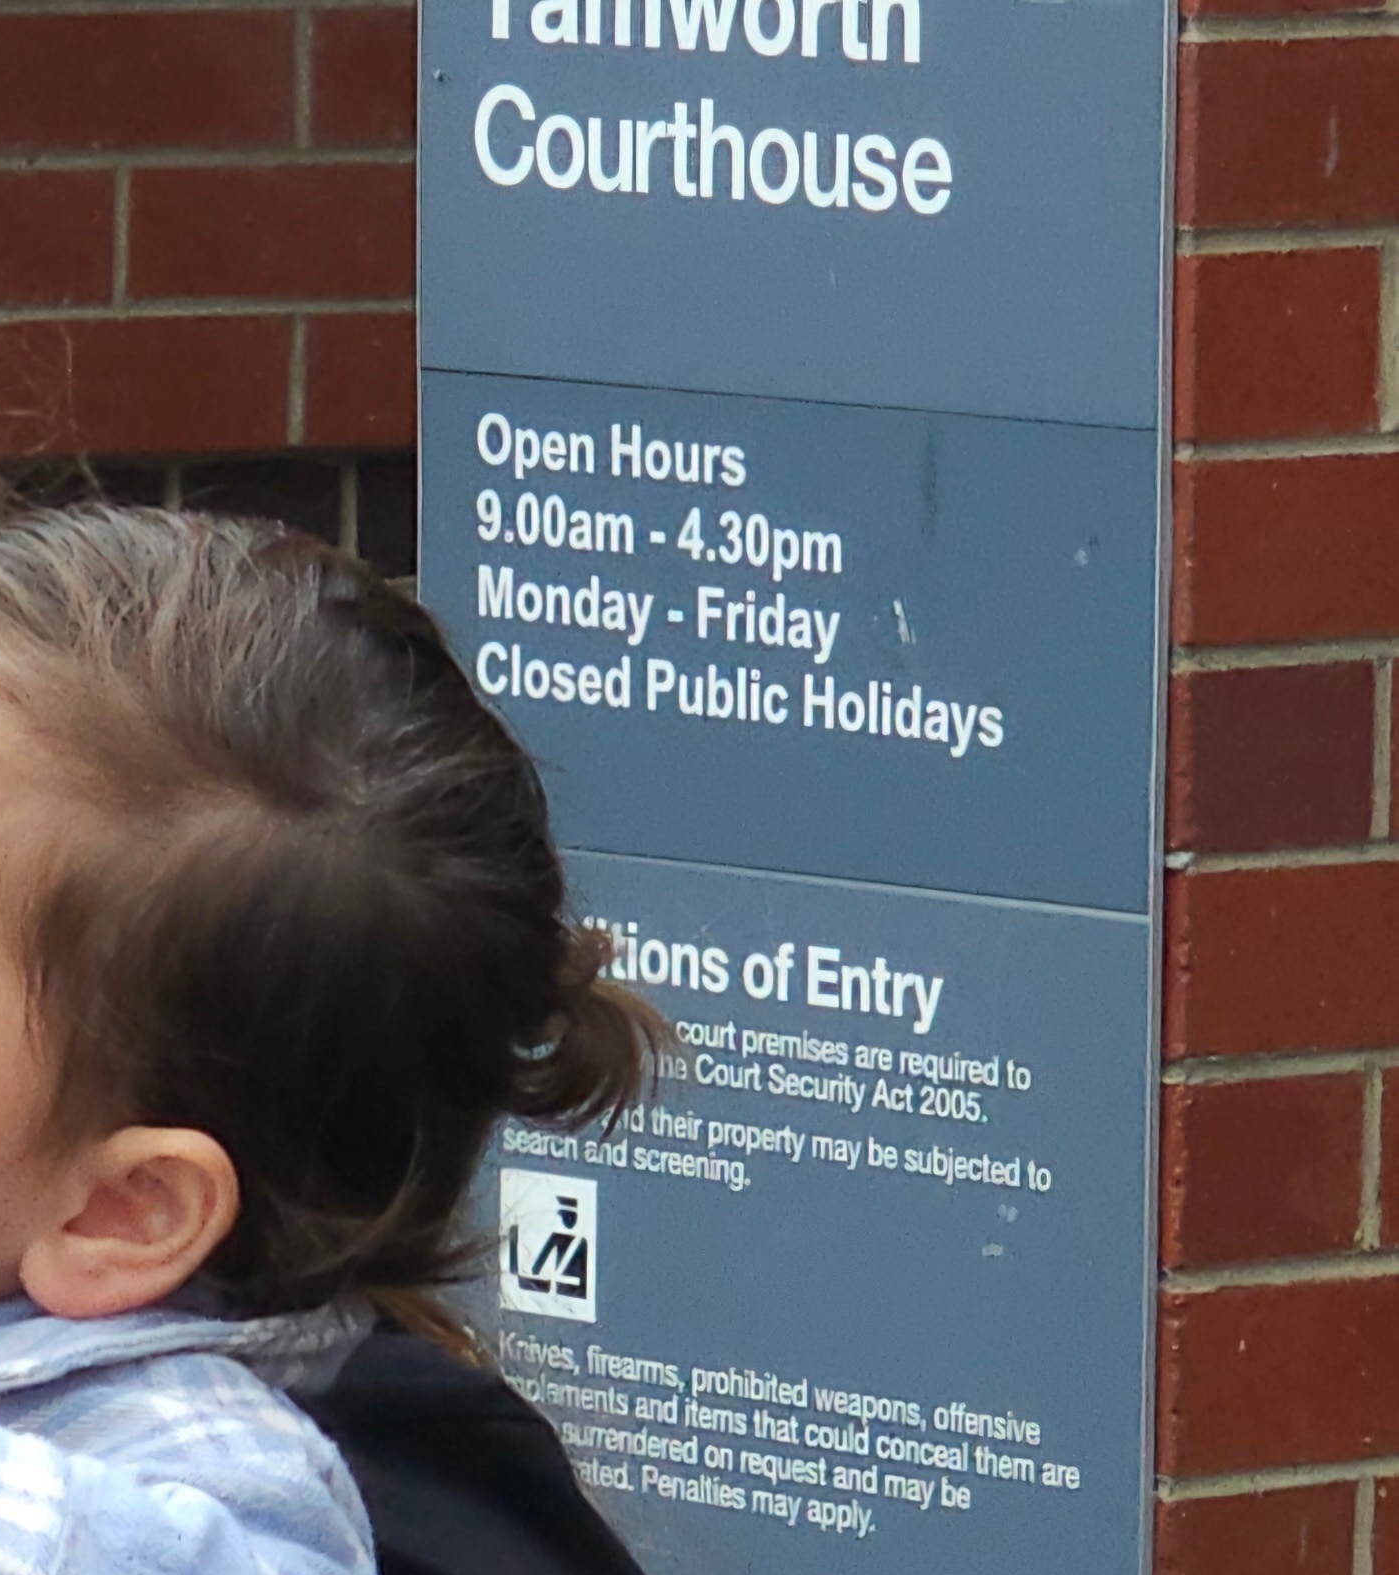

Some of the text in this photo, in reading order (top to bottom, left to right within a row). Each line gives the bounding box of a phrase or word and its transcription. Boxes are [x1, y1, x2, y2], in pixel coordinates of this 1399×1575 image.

[475, 83, 953, 214] Courthouse
[478, 413, 746, 486] Open Hours
[477, 490, 633, 553] 9.00am
[678, 508, 841, 581] 4.30pm
[479, 565, 653, 645] Monday
[698, 587, 840, 664] Friday
[477, 642, 1003, 757] Closed Public Holidays
[595, 920, 943, 1034] tions of Entry
[653, 1050, 987, 1122] he Court Security Act 2005.
[676, 1020, 1031, 1090] court premises are required to
[504, 1128, 750, 1191] search and screening.
[652, 1107, 702, 1140] their
[708, 1122, 805, 1162] property
[812, 1136, 861, 1169] may
[868, 1137, 897, 1168] be
[905, 1146, 1020, 1186] subjected
[1028, 1161, 1051, 1191] to
[587, 1345, 687, 1393] firearms,
[692, 1366, 807, 1407] prohibited
[815, 1388, 926, 1431] weapons,
[934, 1402, 1040, 1445] offensive
[561, 1422, 970, 1510] surrendered on request and may be
[635, 1395, 678, 1425] and
[685, 1396, 747, 1436] items
[754, 1410, 799, 1444] that
[805, 1421, 869, 1455] could
[874, 1436, 968, 1479] conceal
[975, 1446, 1034, 1482] them
[1043, 1463, 1079, 1489] are
[642, 1465, 746, 1509] Penalties
[753, 1480, 801, 1525] may
[808, 1500, 875, 1537] apply.
